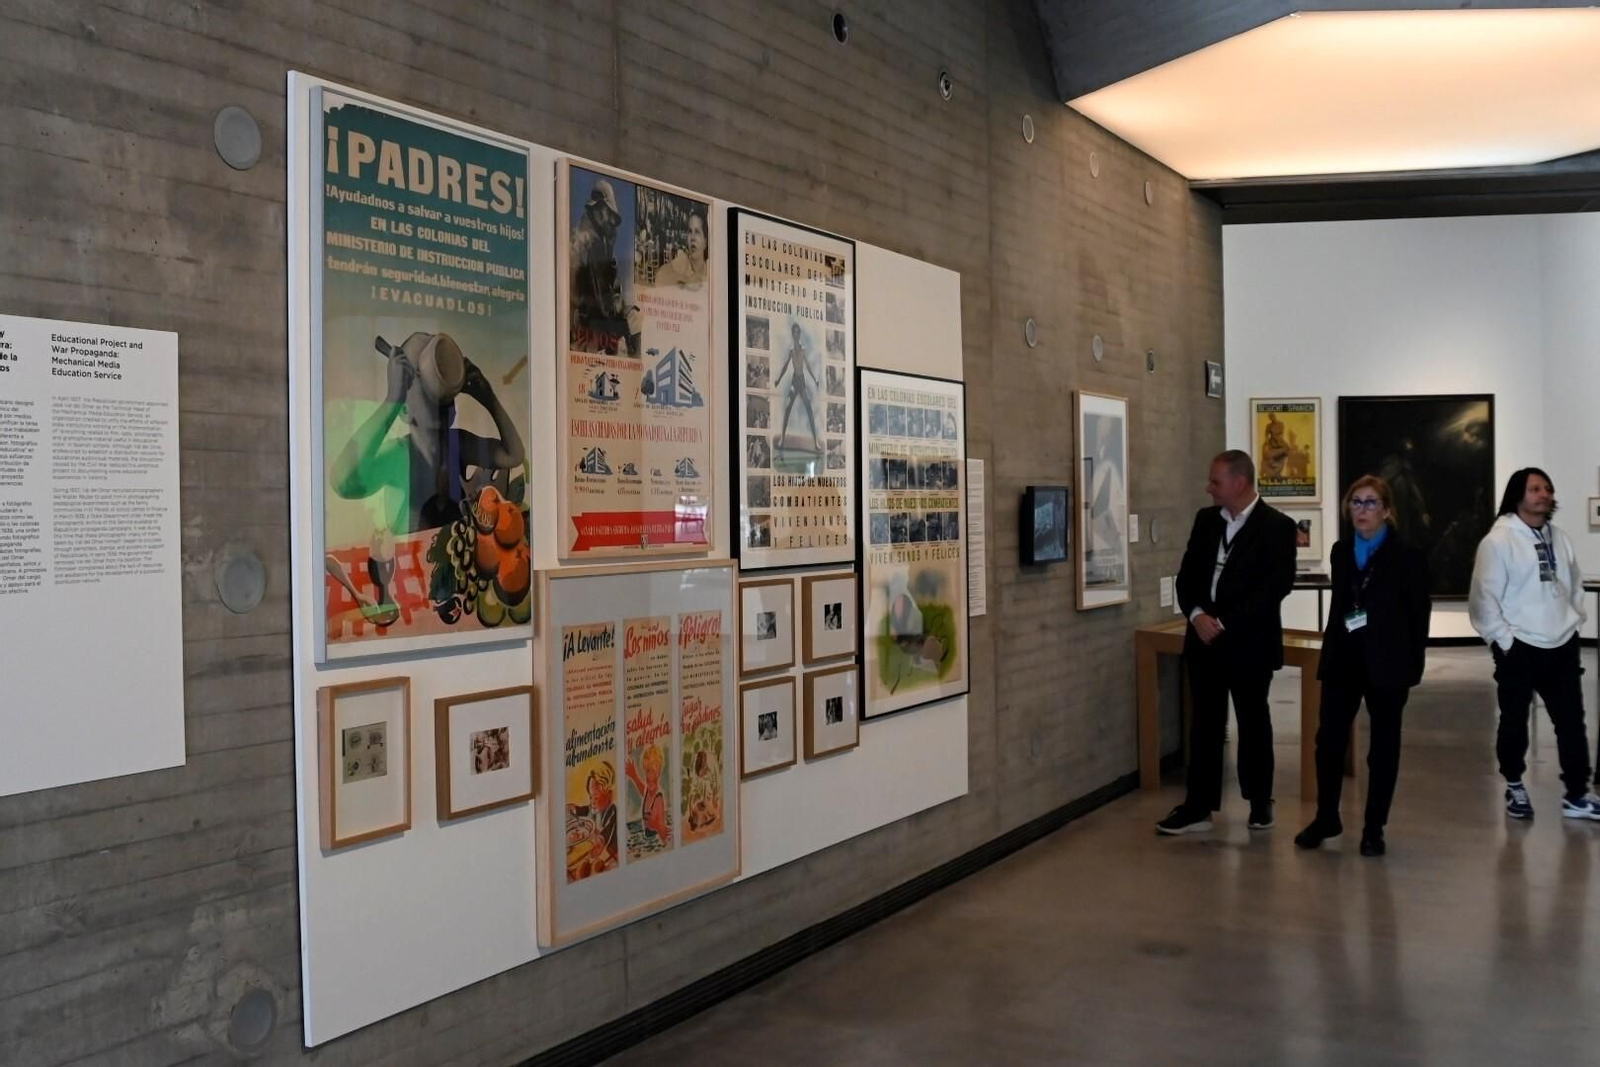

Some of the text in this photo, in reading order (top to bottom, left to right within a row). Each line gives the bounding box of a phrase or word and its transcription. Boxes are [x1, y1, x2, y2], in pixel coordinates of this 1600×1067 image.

[327, 125, 524, 219] ¡PADRES!
[398, 202, 405, 213] a
[408, 205, 443, 221] salvar
[444, 213, 451, 222] a
[453, 215, 498, 234] vuestros
[500, 223, 524, 241] hijos!
[371, 216, 491, 253] EN LAS COLONIAS DEL
[326, 231, 525, 281] MINISTERIO DE INSTRUCCION PUBLICA
[745, 232, 823, 264] EN LAS COLONIAS
[327, 255, 378, 276] tendrán
[745, 254, 823, 282] ESCOLARES DEL
[745, 274, 823, 302] MINISTERIO DE
[745, 295, 823, 321] INSTRUCCION PUBLICA
[51, 333, 98, 345] Educational
[100, 338, 127, 349] Project
[10, 353, 18, 361] la
[51, 345, 120, 359] War Propaganda:
[51, 357, 121, 369] Mechanical Media
[51, 368, 122, 380] Education Service
[773, 476, 785, 487] LOS
[807, 477, 815, 487] DE
[773, 496, 847, 507] COMBATIENTES
[773, 514, 847, 527] VIVEN SANOS
[789, 534, 848, 547] FELICES
[932, 547, 960, 560] FELICES
[577, 624, 615, 655] Levante!
[624, 622, 669, 659] Los niños
